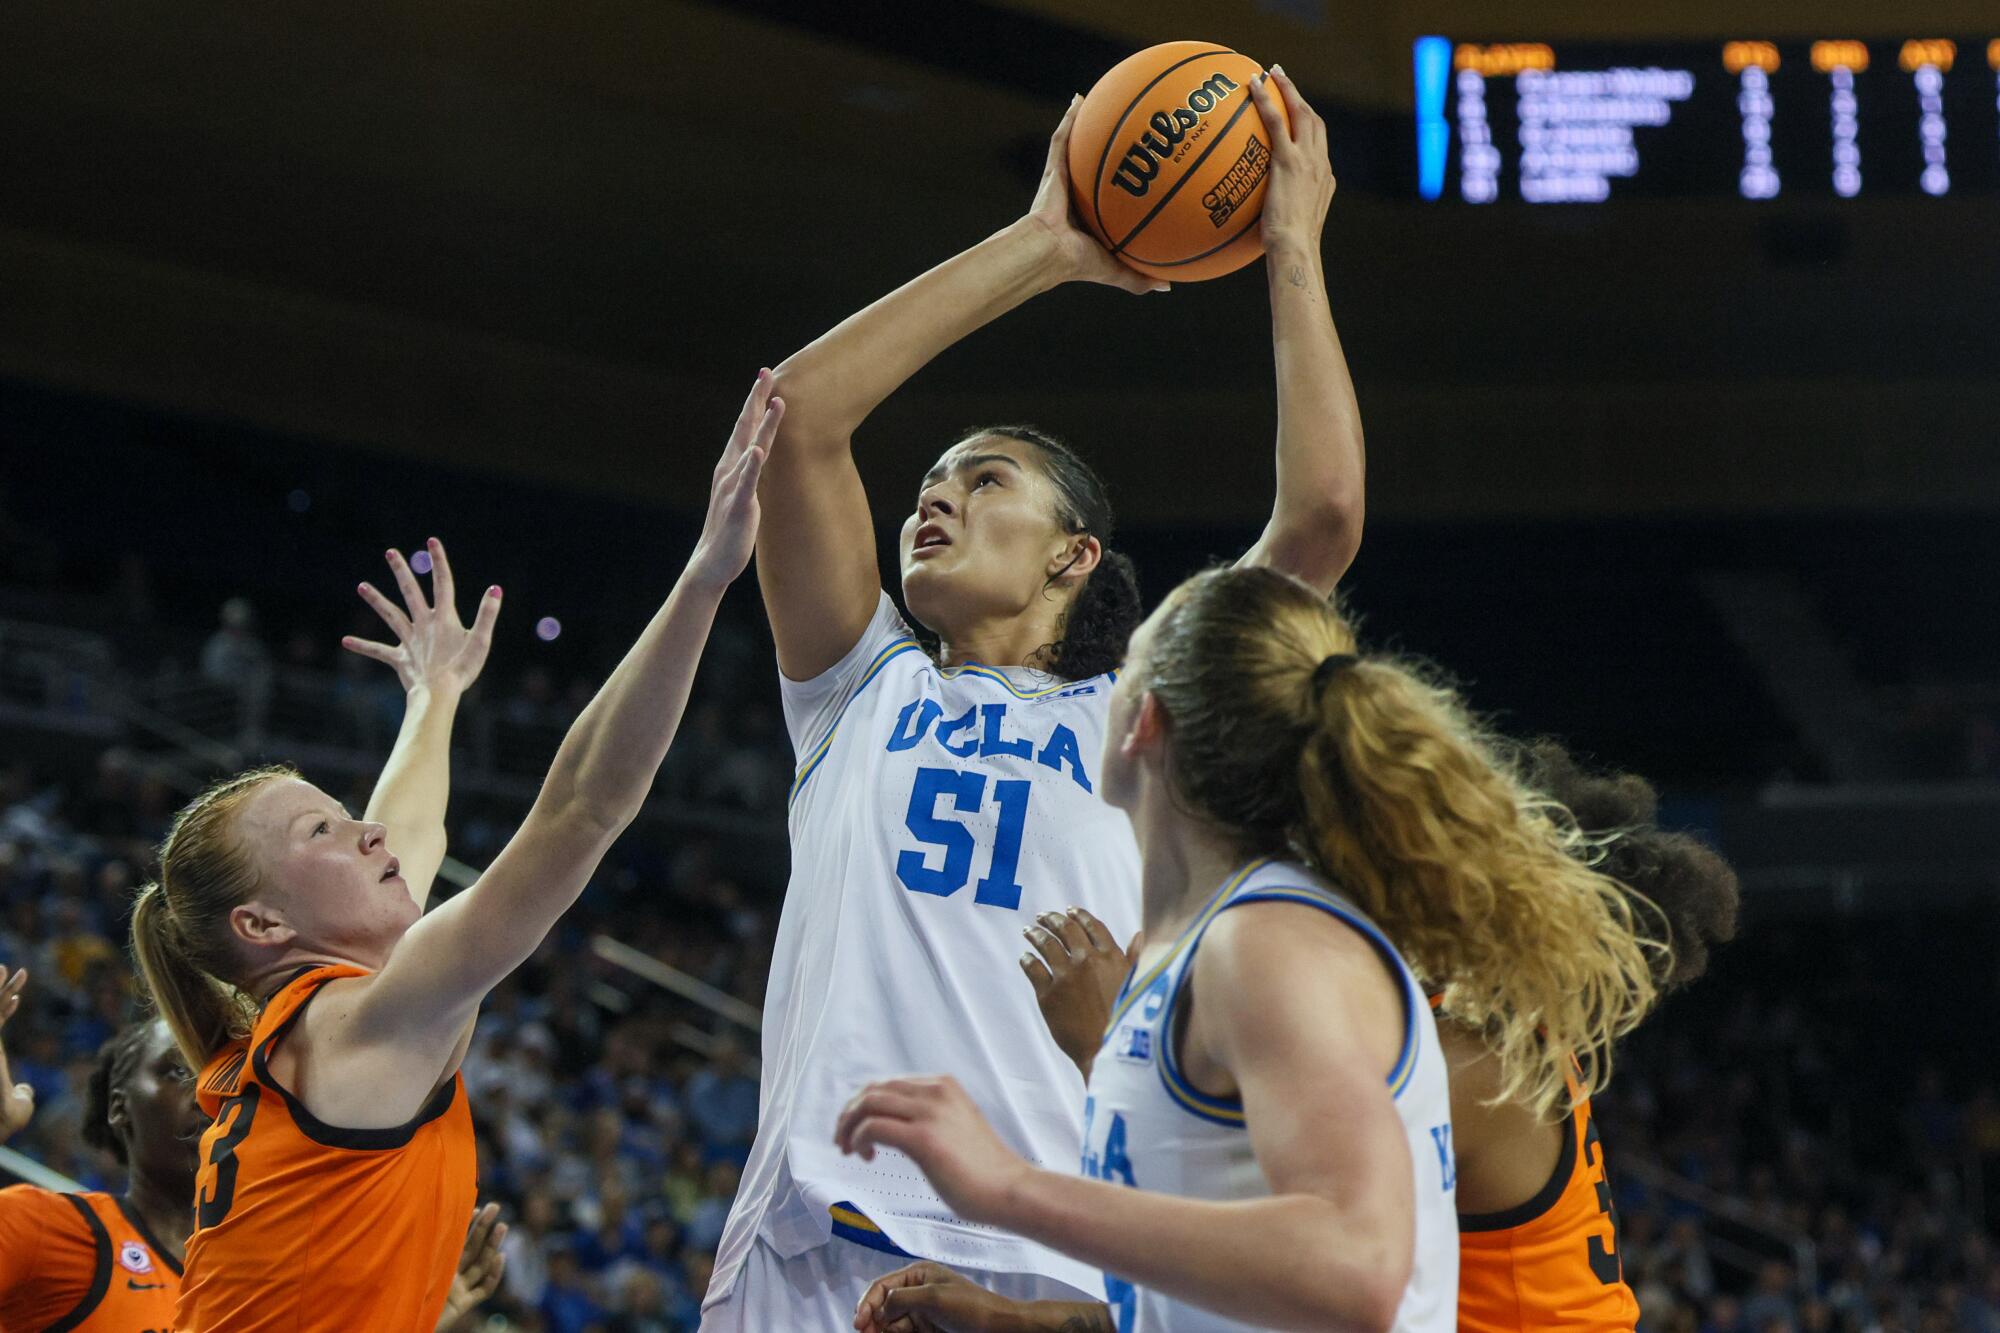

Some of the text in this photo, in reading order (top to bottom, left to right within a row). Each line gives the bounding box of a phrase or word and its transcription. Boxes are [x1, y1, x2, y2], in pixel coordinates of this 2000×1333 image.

[1111, 72, 1240, 197] Wilson
[1173, 120, 1209, 163] EVO NXT
[1215, 156, 1252, 199] MARCH
[1227, 148, 1270, 205] MADNESS
[886, 698, 1093, 794] UCLA
[896, 767, 1032, 910] 51
